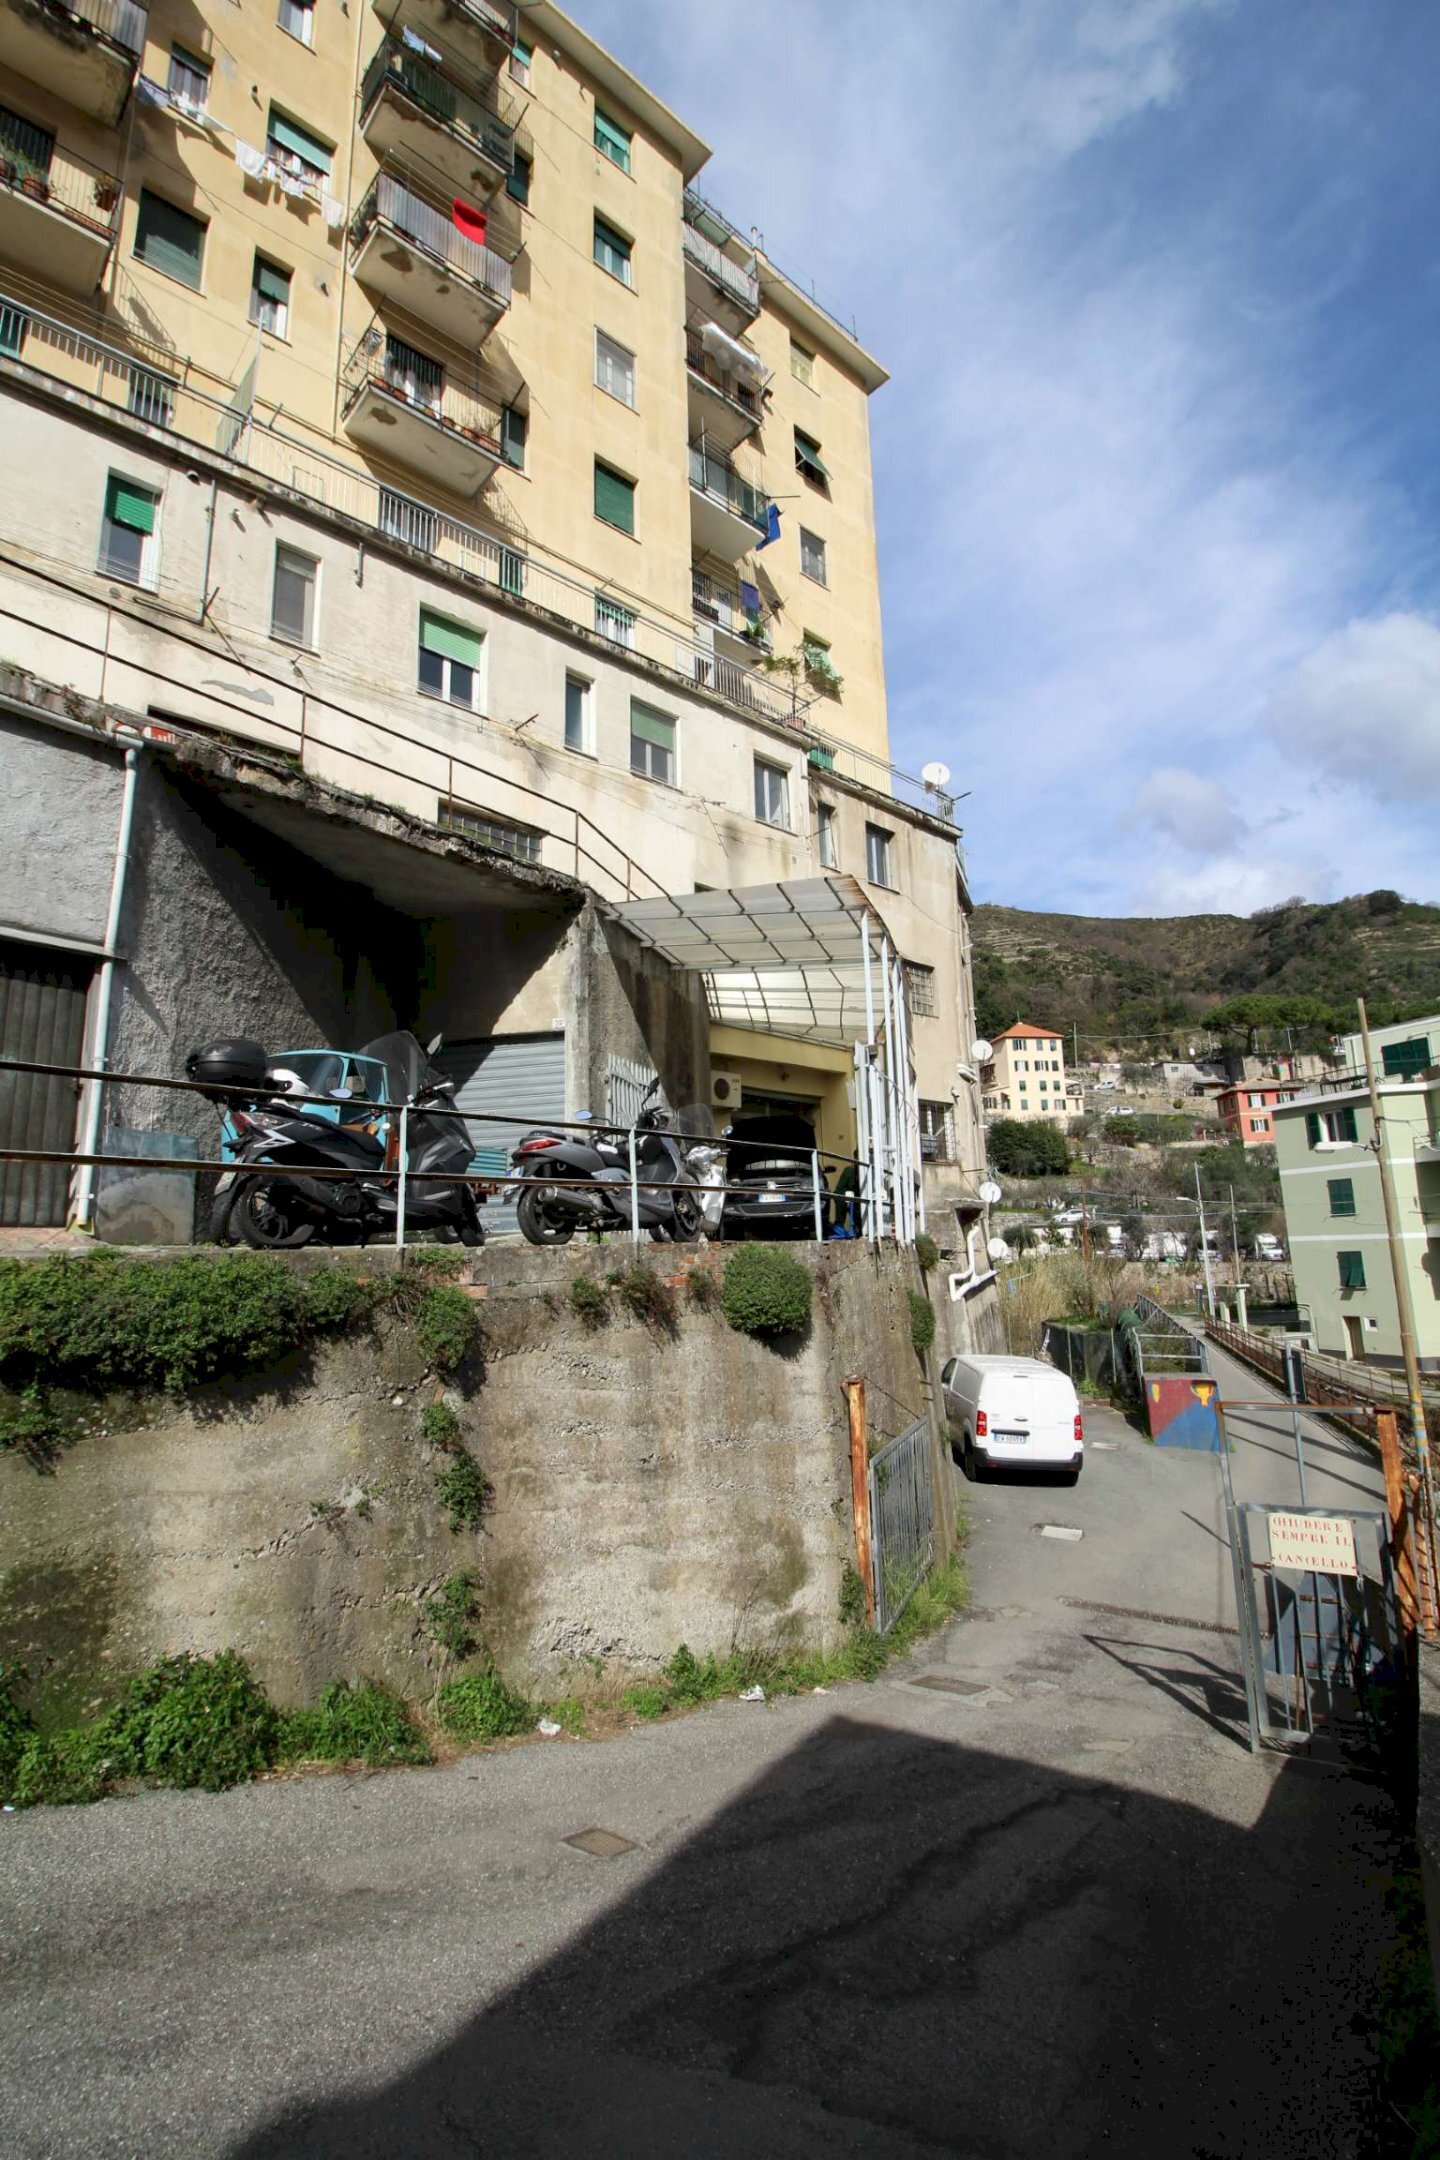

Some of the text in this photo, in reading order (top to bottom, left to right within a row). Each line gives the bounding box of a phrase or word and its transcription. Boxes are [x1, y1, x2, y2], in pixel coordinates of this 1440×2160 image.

[1273, 1517, 1343, 1533] CHIUDERE
[1272, 1530, 1351, 1547] SEMPRE IL
[1278, 1553, 1348, 1569] CANCELLO
